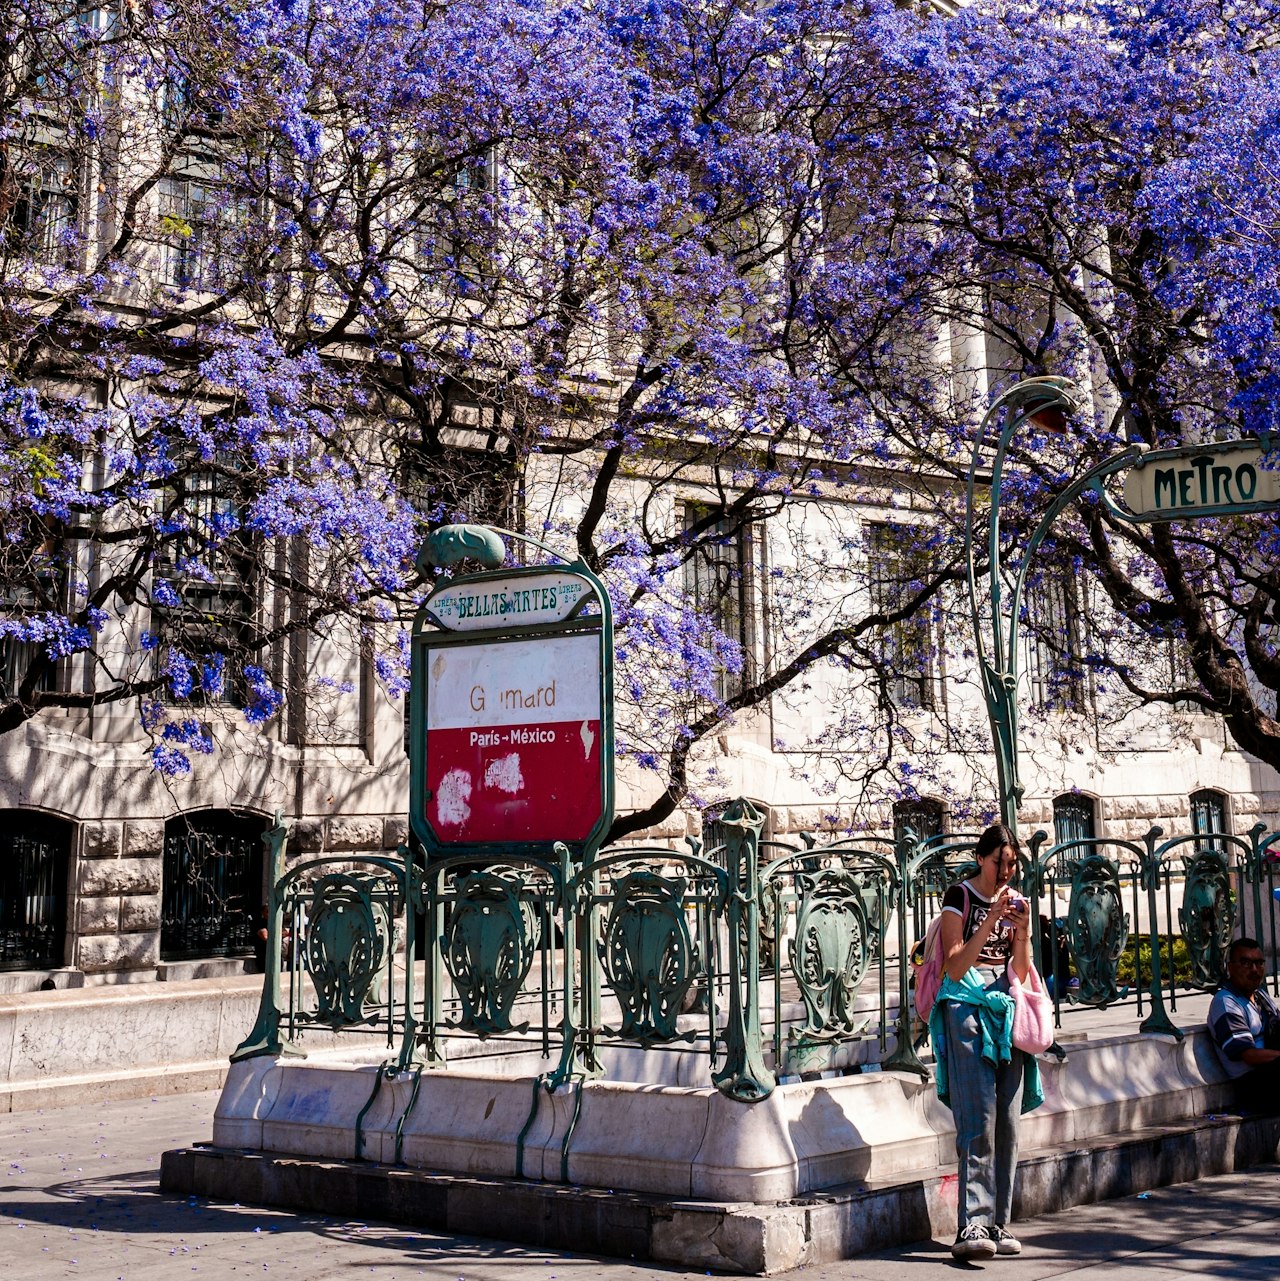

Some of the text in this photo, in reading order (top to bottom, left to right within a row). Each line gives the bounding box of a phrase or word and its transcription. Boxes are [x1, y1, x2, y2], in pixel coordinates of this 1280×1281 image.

[1154, 455, 1257, 508] METRO
[458, 593, 507, 619] BELLAS
[511, 587, 557, 613] ARTES
[470, 727, 555, 746] París México
